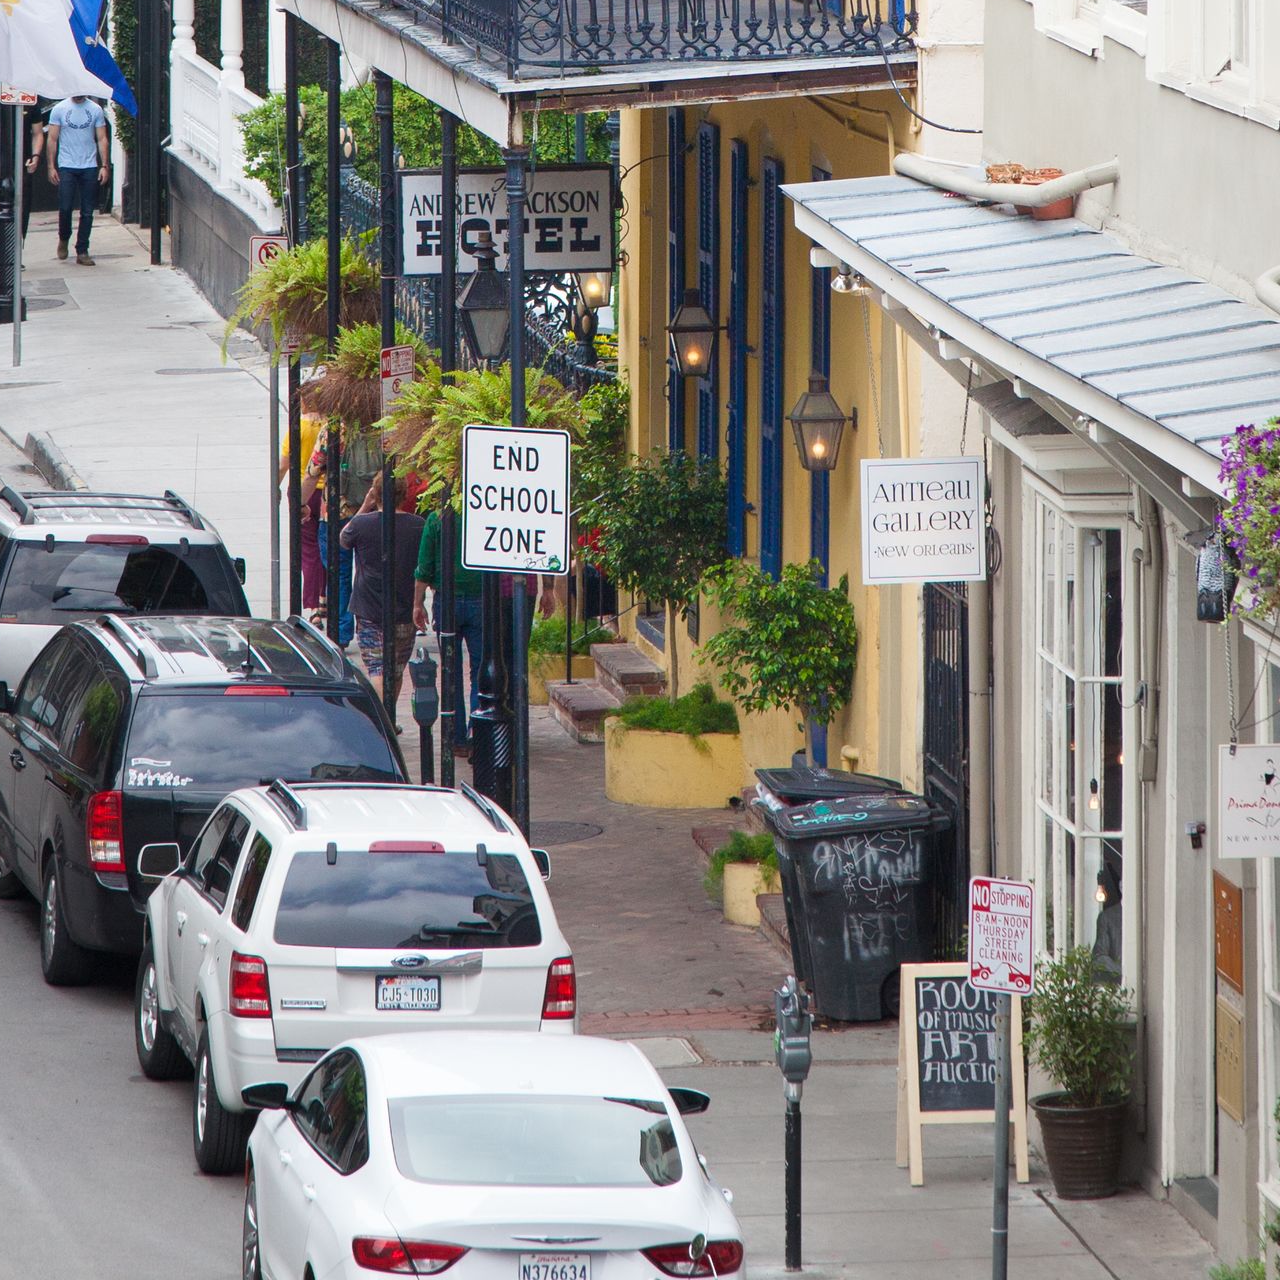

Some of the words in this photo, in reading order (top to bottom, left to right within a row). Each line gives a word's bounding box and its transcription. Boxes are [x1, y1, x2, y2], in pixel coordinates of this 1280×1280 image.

[409, 193, 497, 217] ANREW
[522, 190, 600, 214] ACKSON
[493, 444, 540, 472] END
[469, 484, 563, 515] SCHOOL
[483, 526, 546, 555] ZONE
[973, 884, 990, 908] NO
[991, 890, 1030, 909] STOPPING
[978, 924, 1025, 940] THURSDAY
[984, 937, 1018, 950] STREET
[978, 947, 1023, 963] CLEANING
[918, 980, 997, 1011] ROOT
[918, 1011, 942, 1030] OF
[921, 1031, 997, 1062] ART
[923, 1061, 997, 1084] AUCTIO
[522, 1264, 587, 1280] N376634
